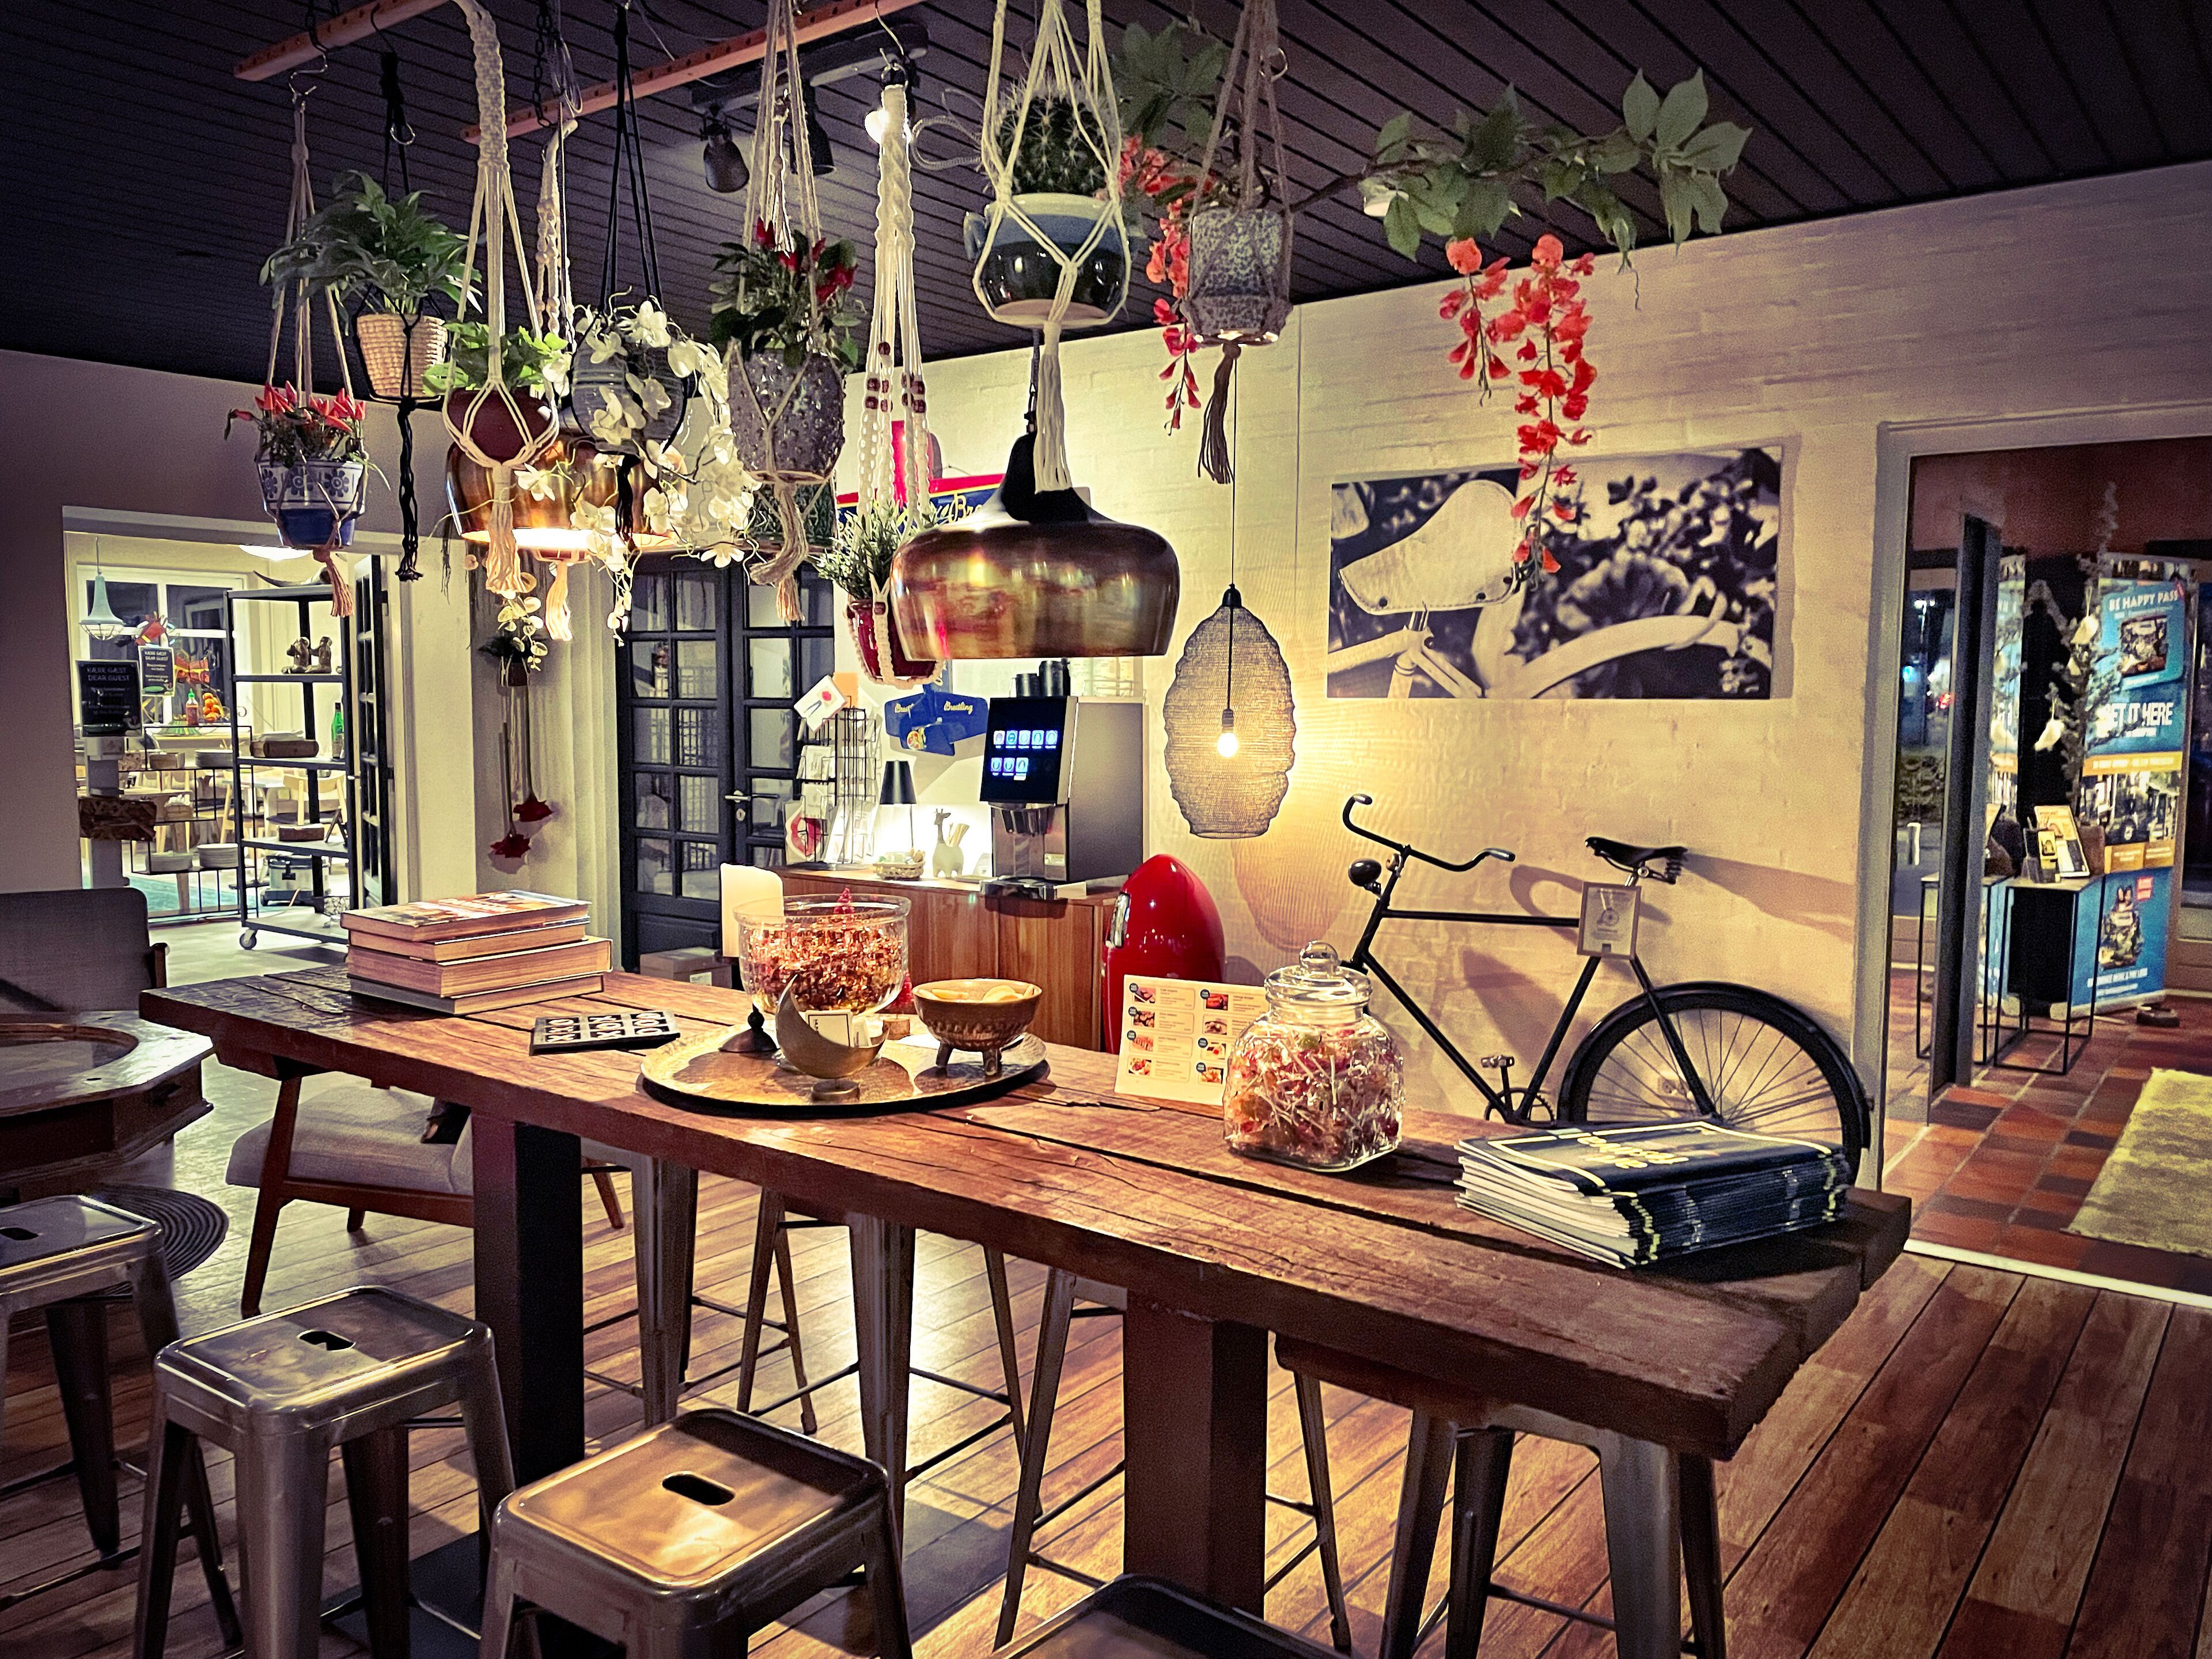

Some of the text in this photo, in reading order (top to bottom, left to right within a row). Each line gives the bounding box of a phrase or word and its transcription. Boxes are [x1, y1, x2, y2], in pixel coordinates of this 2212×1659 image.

[2109, 590, 2178, 612] BE HAPPY PASS
[2128, 702, 2141, 724] IT
[2141, 702, 2174, 726] HERE
